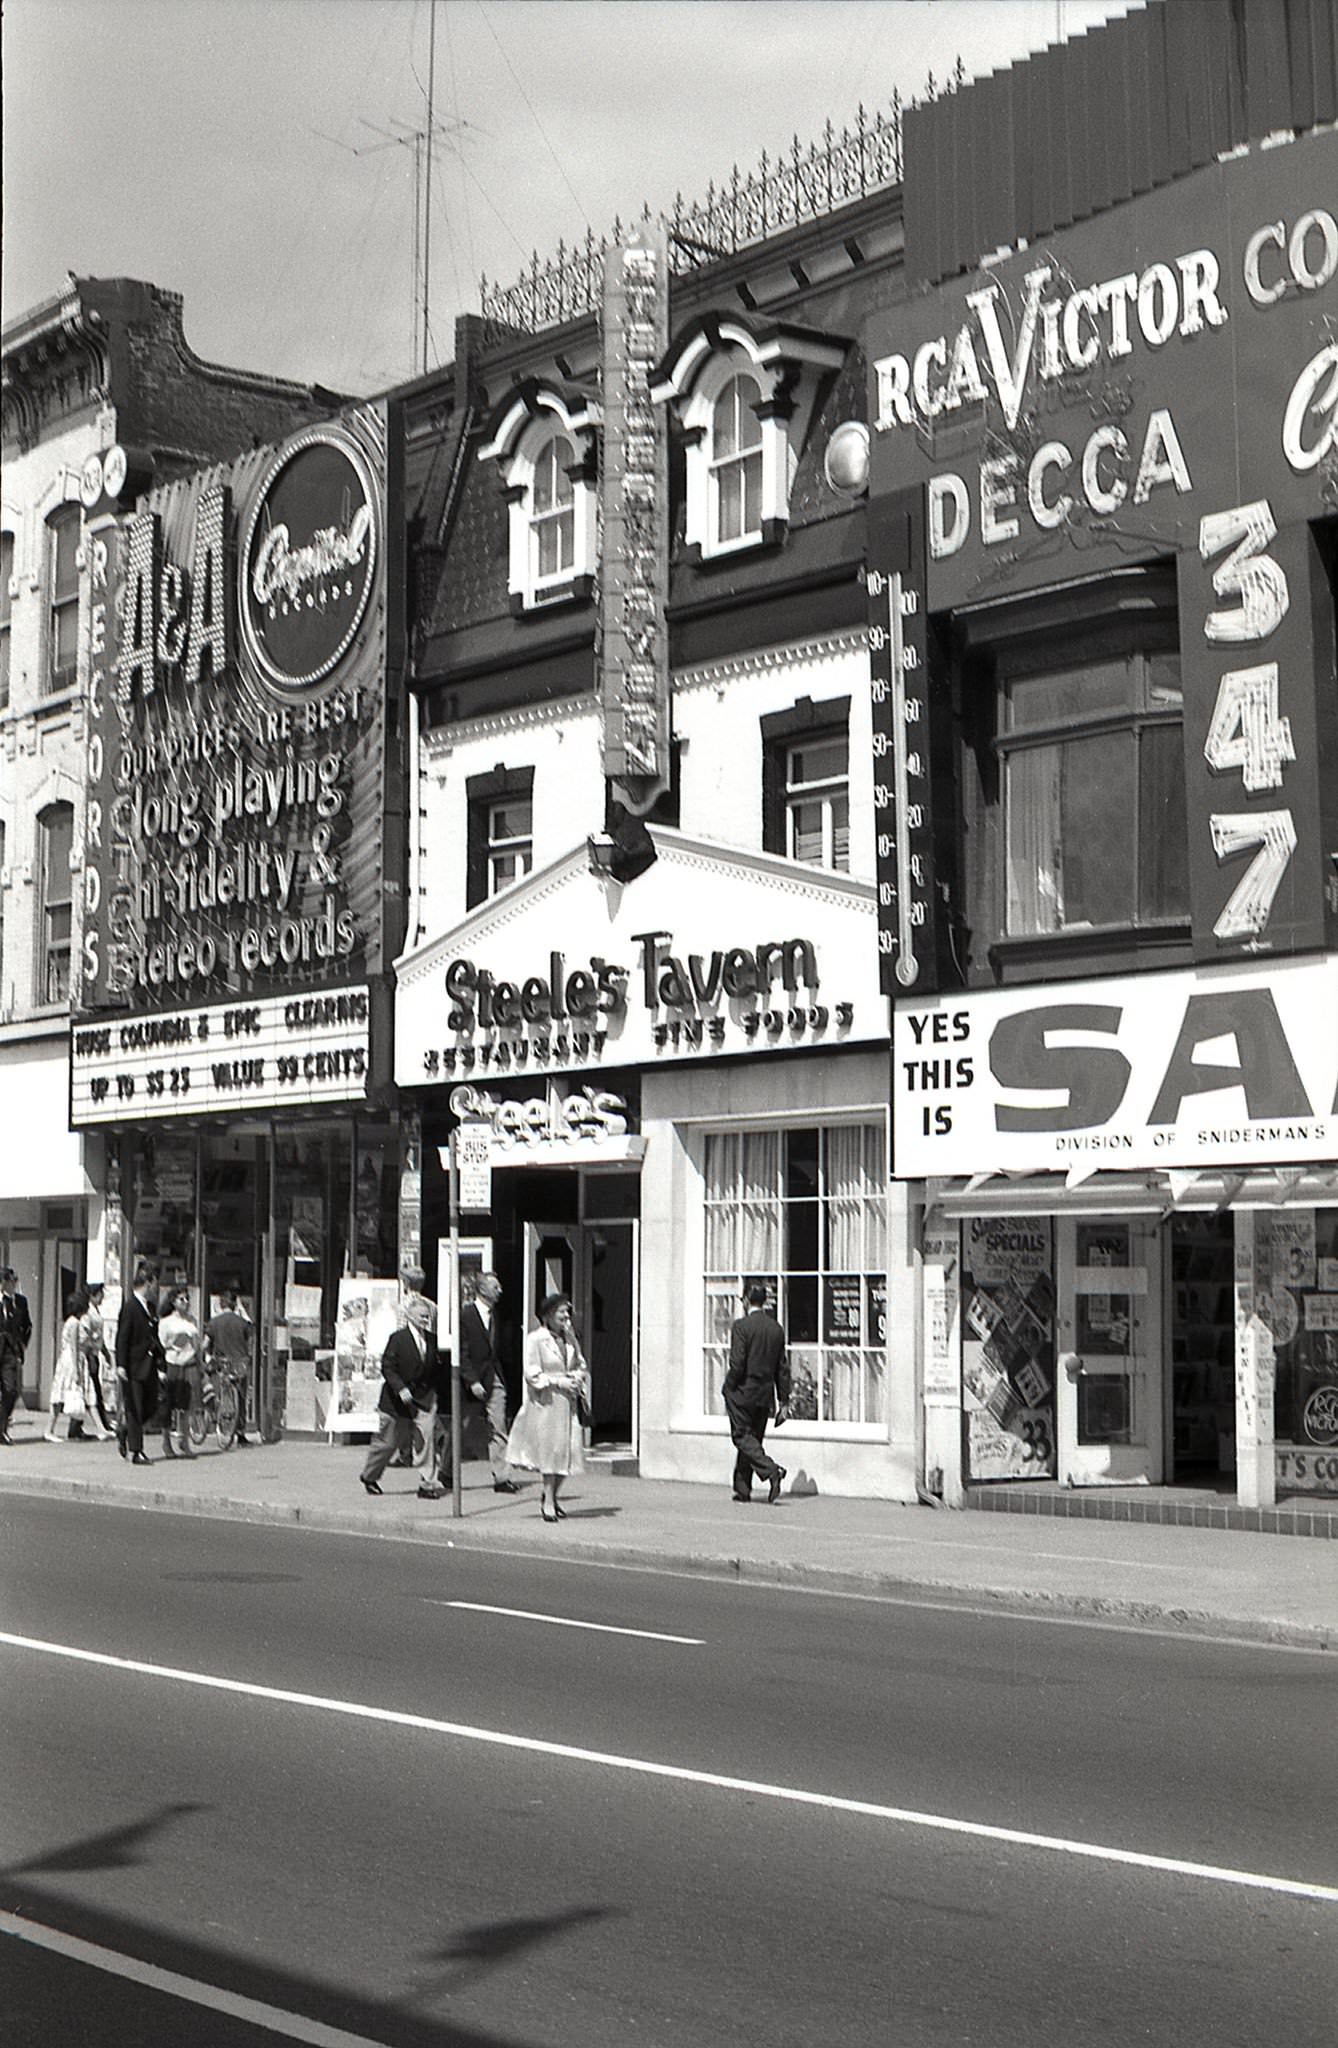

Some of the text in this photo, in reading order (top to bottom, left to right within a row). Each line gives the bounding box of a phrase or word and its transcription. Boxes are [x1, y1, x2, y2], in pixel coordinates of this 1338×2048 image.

[929, 408, 1193, 559] DECCA
[121, 743, 156, 780] OUR
[166, 721, 240, 767] PRICES
[304, 686, 363, 733] BEST
[1199, 499, 1298, 938] 347
[84, 539, 108, 981] RECORDS
[215, 746, 345, 841] playing
[310, 821, 340, 884] &
[228, 892, 355, 971] records
[445, 930, 821, 1031] Steele's Tavern
[120, 1017, 192, 1050] COLUMBIA
[198, 1014, 209, 1040] &
[224, 1008, 261, 1037] EPIC
[423, 1001, 855, 1070] RESTAURANT FINE FOODS
[908, 1011, 970, 1045] YES
[90, 1077, 109, 1103] UP
[116, 1074, 134, 1100] TO
[211, 1058, 265, 1090] VALUE
[277, 1056, 299, 1083] 99
[304, 1048, 366, 1082] CENTS
[903, 1057, 974, 1091] THIS
[465, 1140, 488, 1152] BUS
[923, 1106, 953, 1136] IS
[1056, 1124, 1327, 1151] DIVISION OF SNIDERMAN'S
[463, 1153, 489, 1164] STOP
[986, 1233, 1046, 1251] SPECIALS
